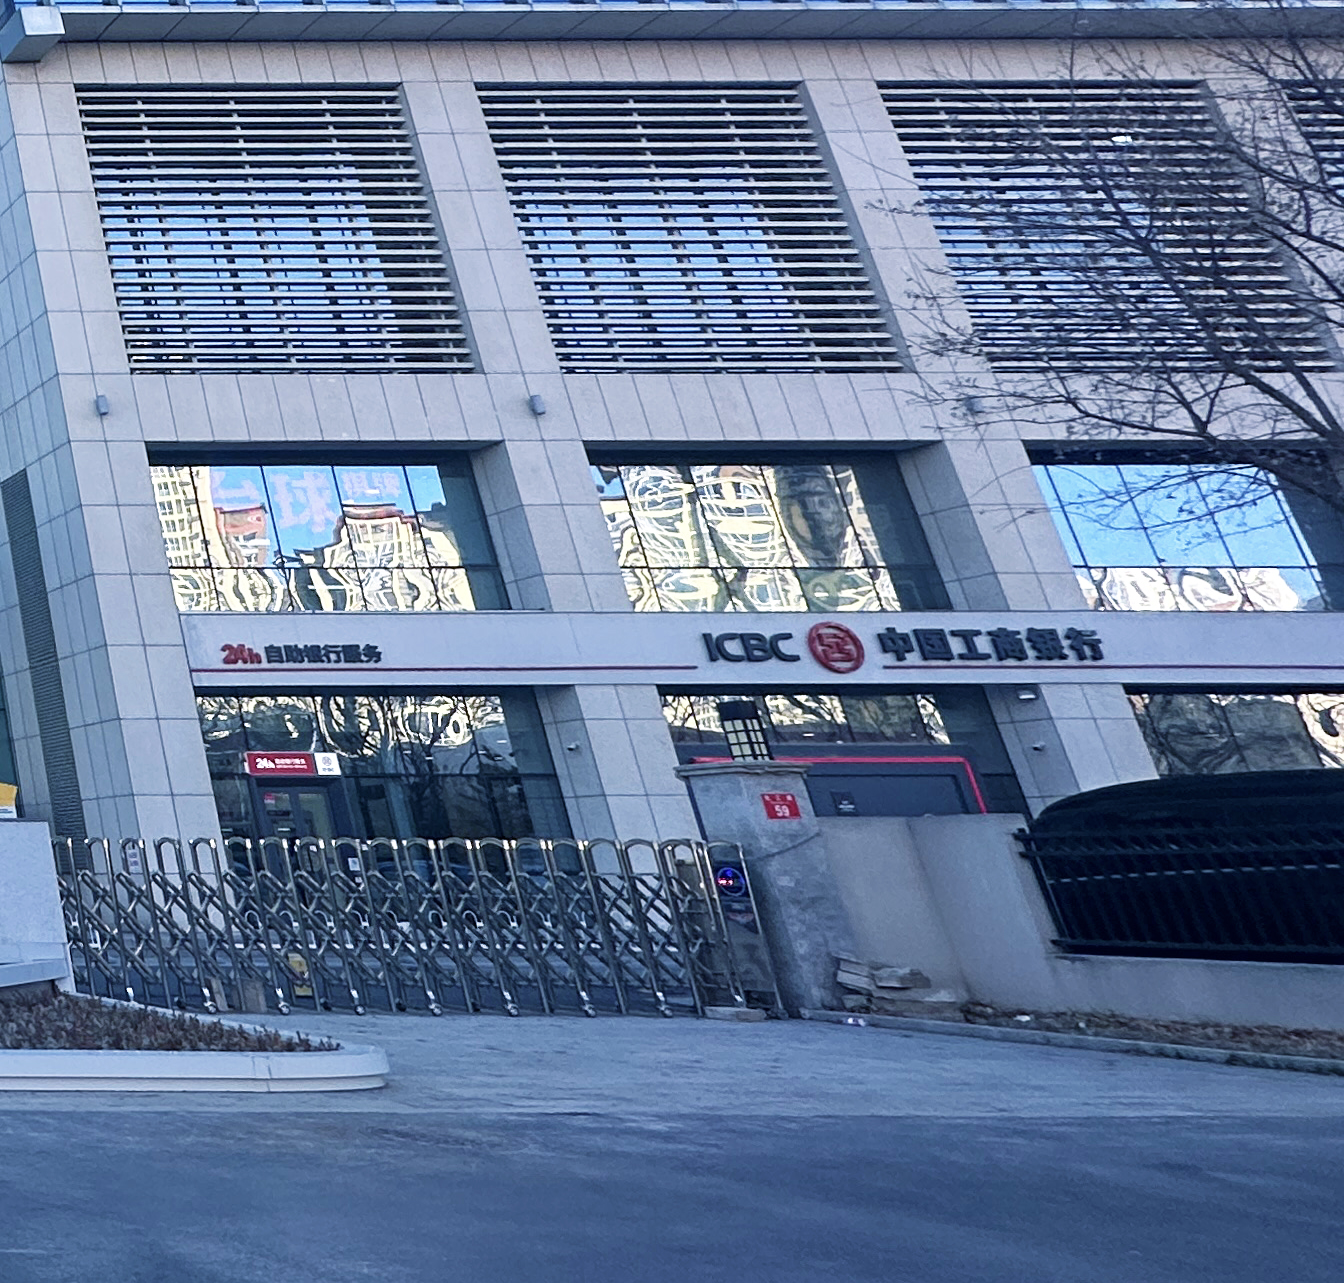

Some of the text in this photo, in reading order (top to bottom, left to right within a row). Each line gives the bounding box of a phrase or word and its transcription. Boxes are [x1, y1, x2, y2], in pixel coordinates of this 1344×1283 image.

[220, 643, 383, 665] 24h 自助银行服务
[702, 626, 1105, 663] ICBC 中国工商银行
[773, 804, 791, 818] 59
